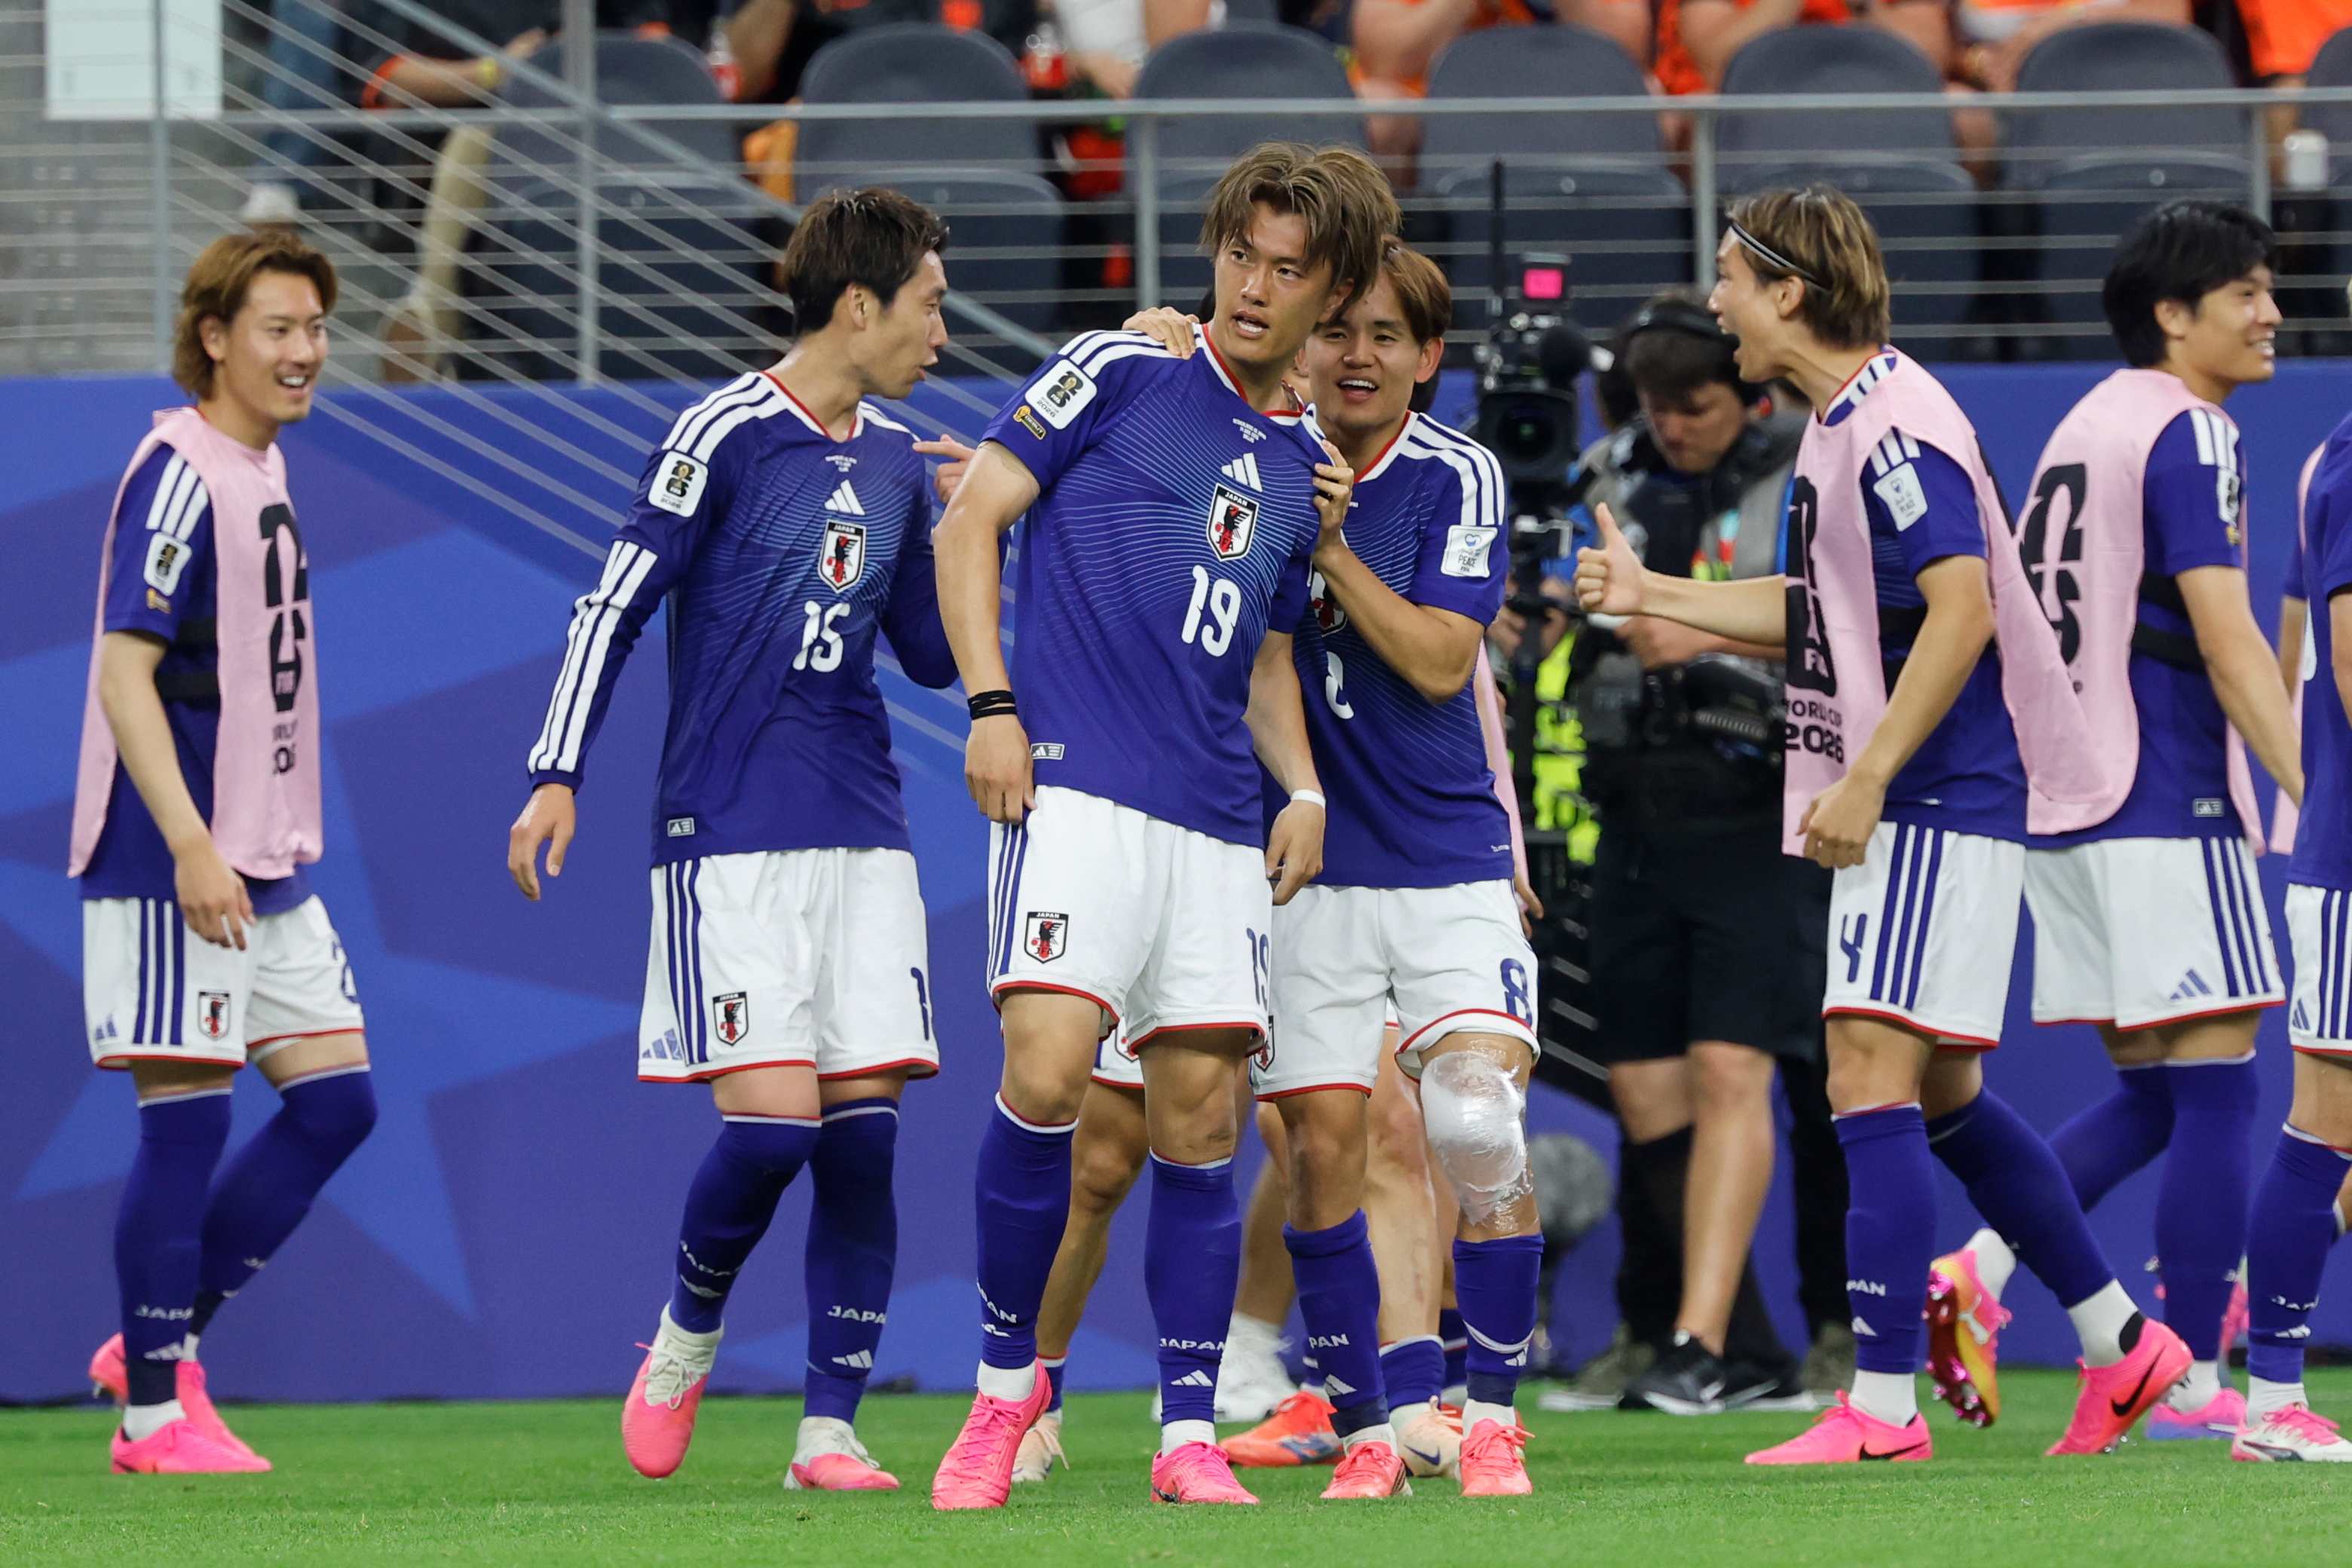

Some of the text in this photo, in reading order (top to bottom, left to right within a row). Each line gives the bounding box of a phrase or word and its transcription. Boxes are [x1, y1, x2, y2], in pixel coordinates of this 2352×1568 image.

[1224, 492, 1248, 507] JAPAN
[792, 599, 851, 673] 15
[1181, 565, 1242, 657] 19
[1839, 913, 1868, 983] 4
[1499, 957, 1533, 1027] 8
[1845, 1279, 1886, 1297] PAN
[1308, 1333, 1350, 1350] PAN
